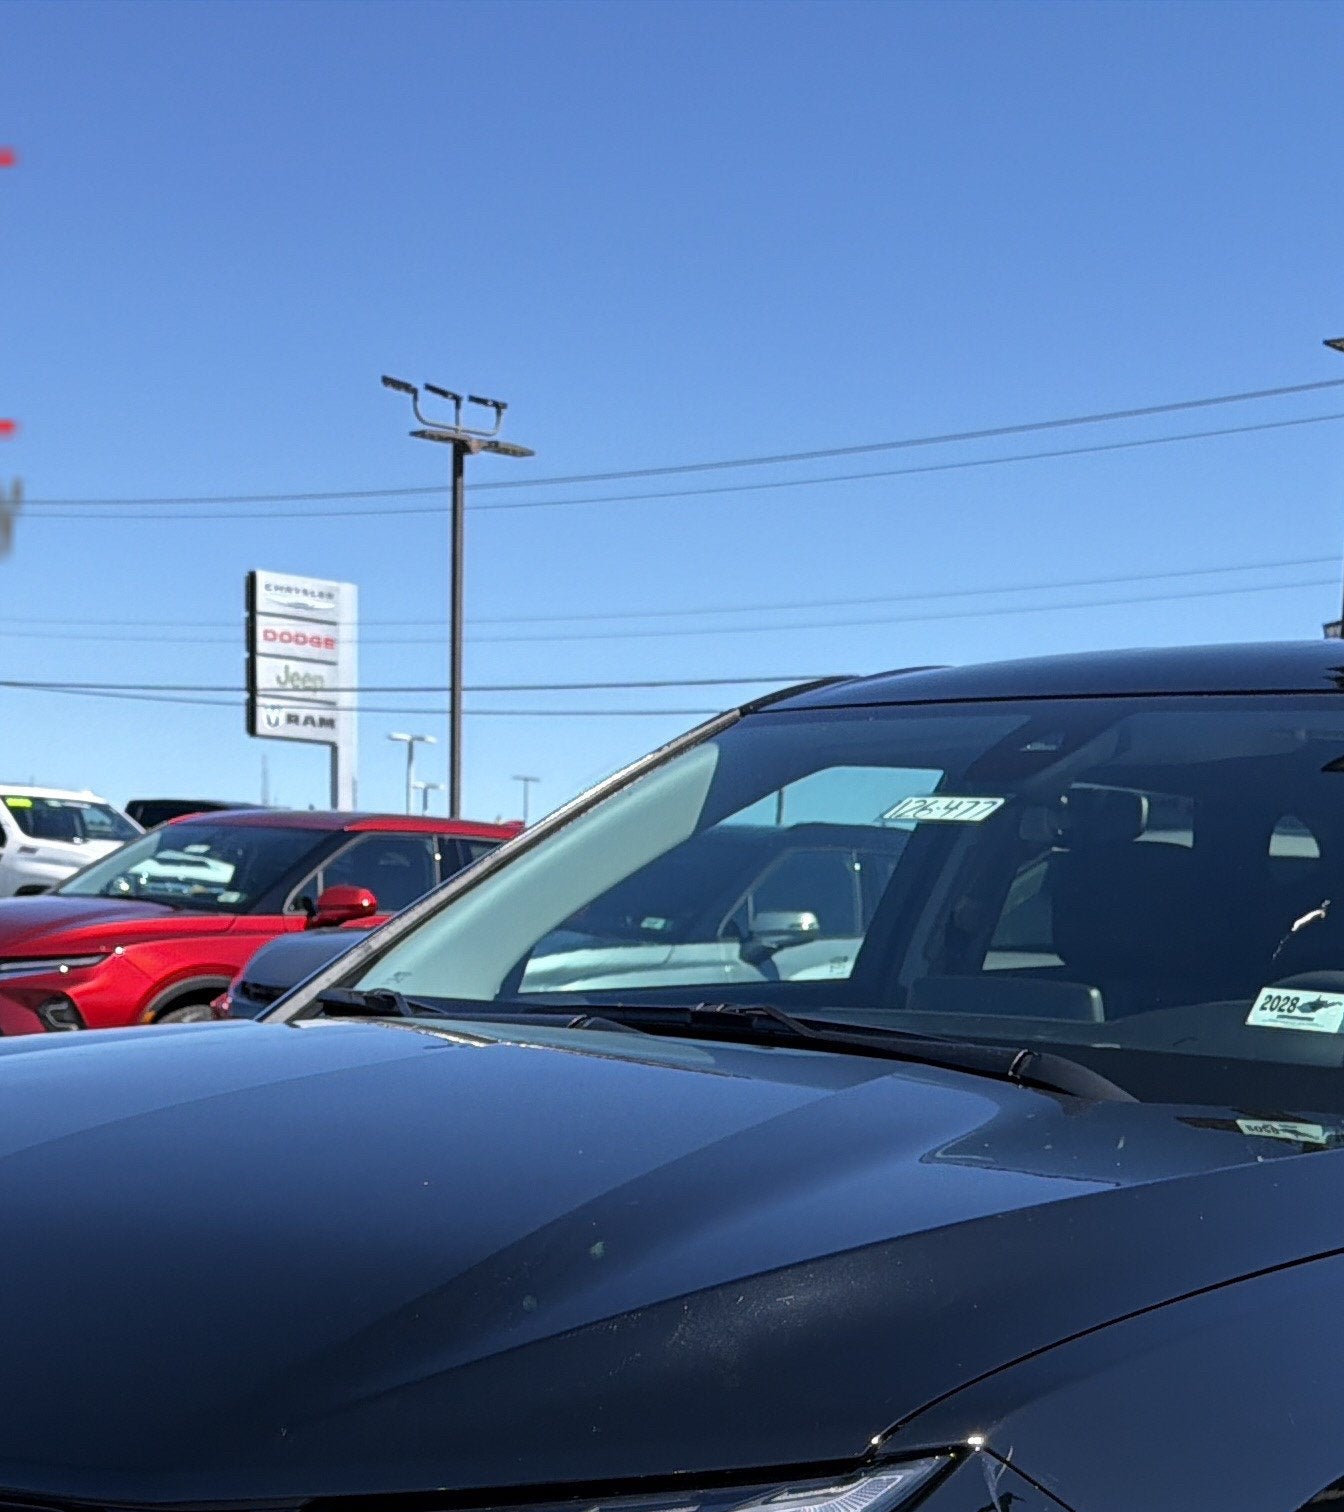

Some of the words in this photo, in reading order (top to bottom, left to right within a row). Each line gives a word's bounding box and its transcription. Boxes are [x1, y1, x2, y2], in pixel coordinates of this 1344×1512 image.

[263, 581, 336, 600] CHRYSLER
[262, 628, 336, 651] DODGE
[276, 664, 325, 694] Jeep
[286, 712, 336, 730] RAM
[1259, 994, 1301, 1014] 2028
